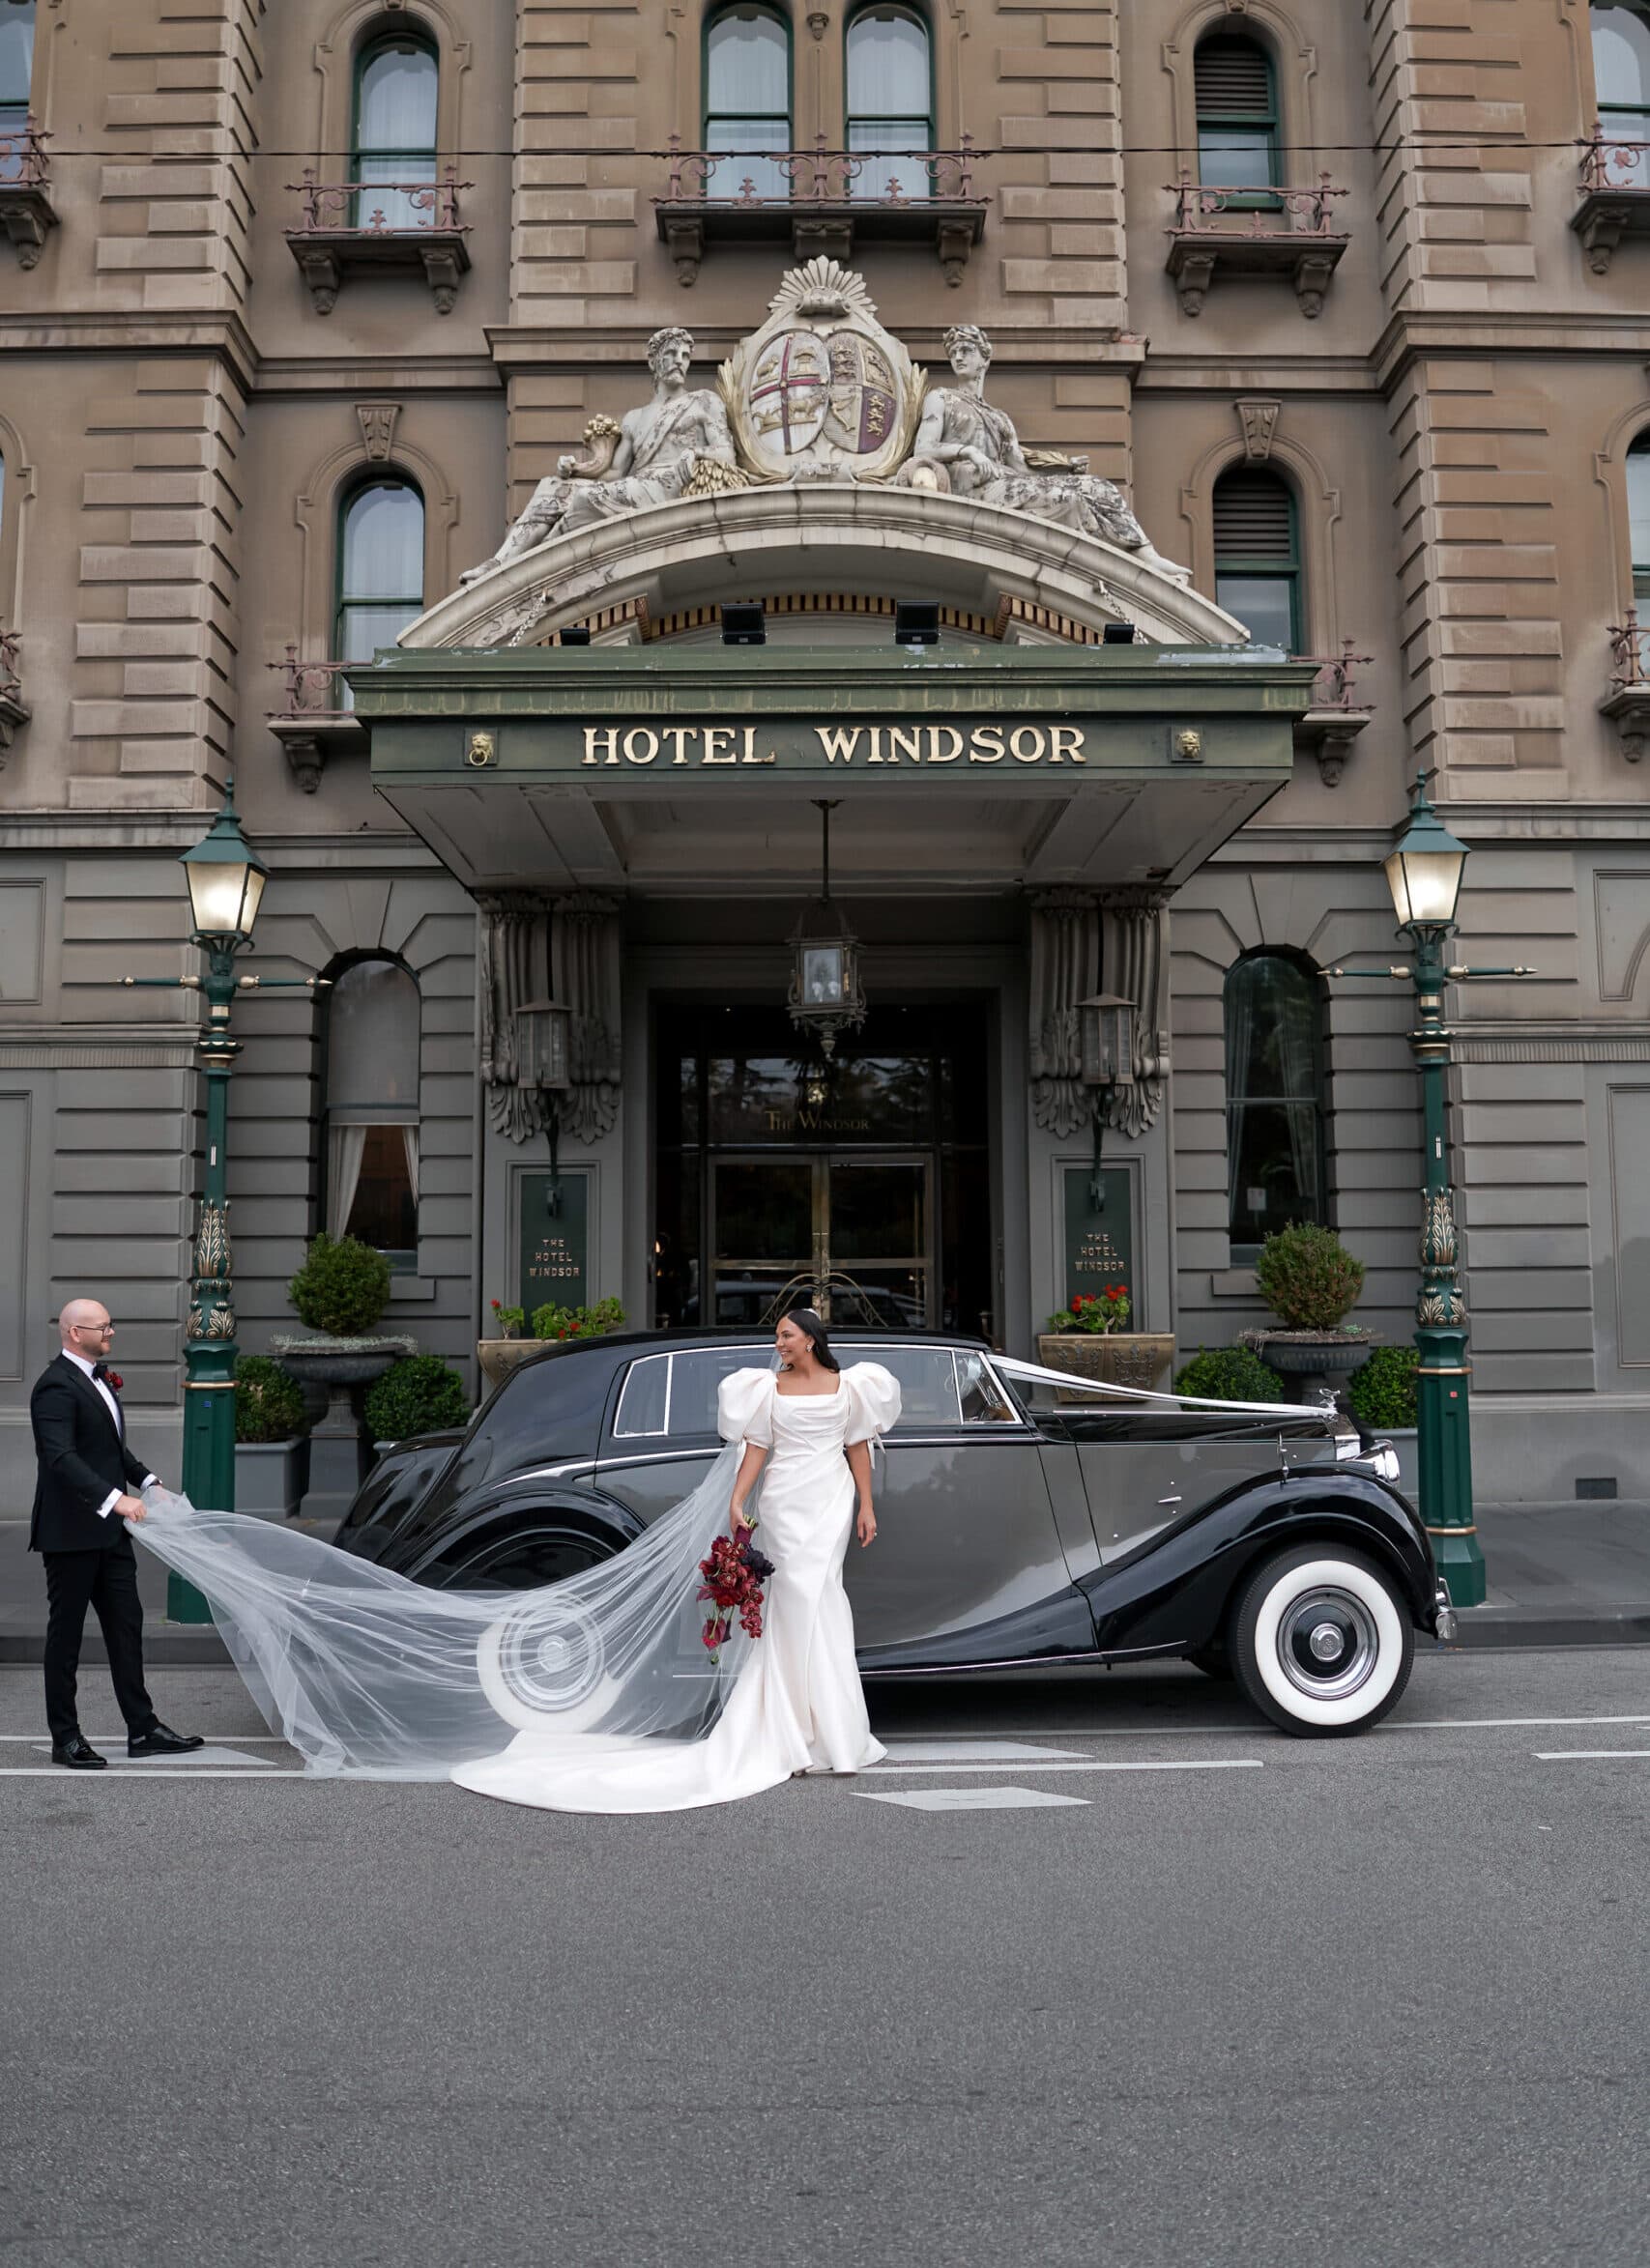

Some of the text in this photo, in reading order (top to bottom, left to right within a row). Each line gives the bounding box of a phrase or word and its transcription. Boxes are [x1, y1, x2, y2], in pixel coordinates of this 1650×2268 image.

[581, 726, 1087, 765] HOTEL WINDSOR
[1086, 1233, 1109, 1242] THE
[542, 1239, 564, 1248] THE
[535, 1251, 572, 1262] HOTEL
[1081, 1247, 1117, 1256] HOTEL
[1075, 1261, 1124, 1272] WINDSOR
[529, 1267, 580, 1277] WINDSOR
